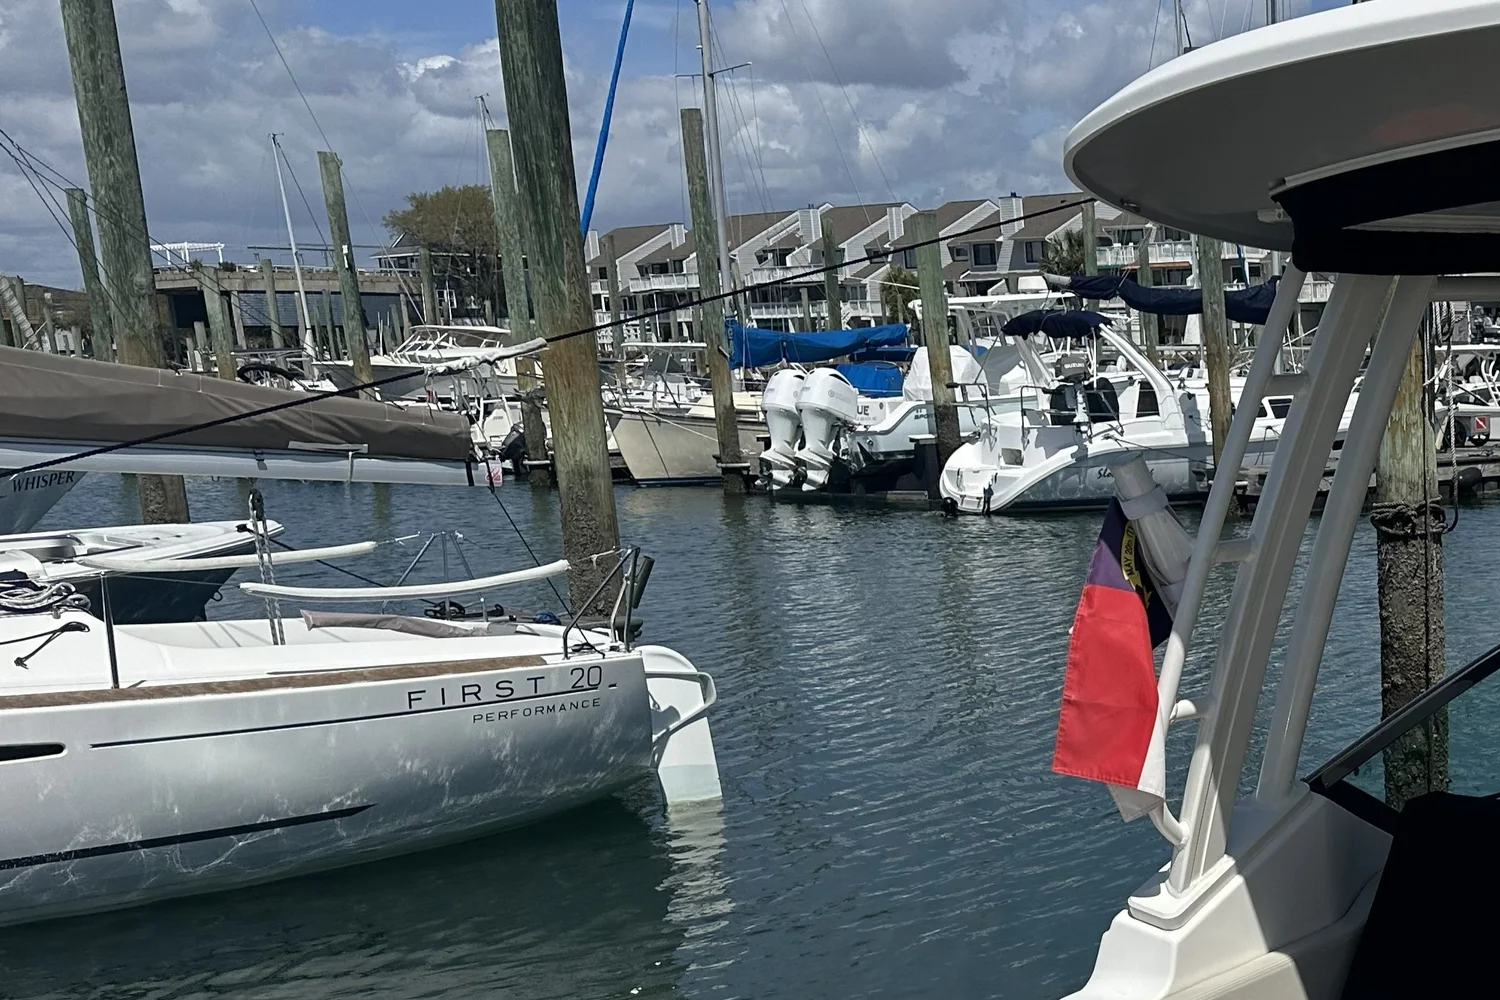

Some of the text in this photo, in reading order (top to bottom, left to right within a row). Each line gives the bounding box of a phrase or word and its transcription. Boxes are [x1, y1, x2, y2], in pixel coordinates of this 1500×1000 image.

[12, 471, 75, 492] WHISPER
[1123, 556, 1136, 576] MAY
[407, 665, 602, 709] FIRST 20
[472, 697, 601, 724] PERFORMANCE
